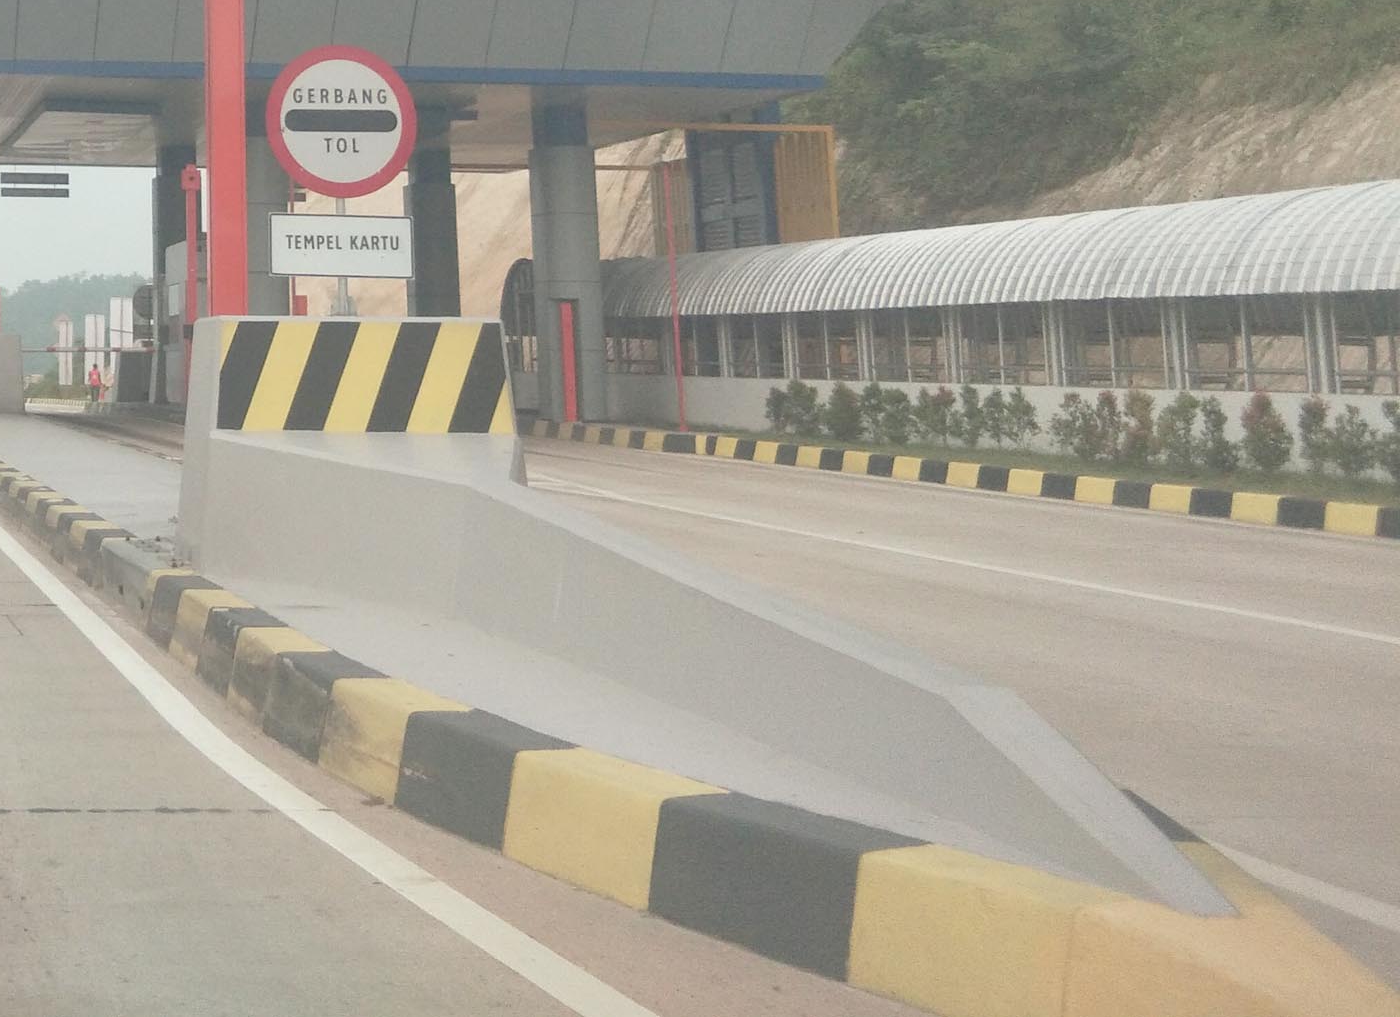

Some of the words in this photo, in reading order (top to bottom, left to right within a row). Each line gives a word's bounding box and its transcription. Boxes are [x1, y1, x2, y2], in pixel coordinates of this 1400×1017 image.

[293, 88, 387, 104] GERBANG
[324, 138, 359, 153] TOL
[286, 234, 342, 250] TEMPEL
[350, 235, 399, 251] KARTU
